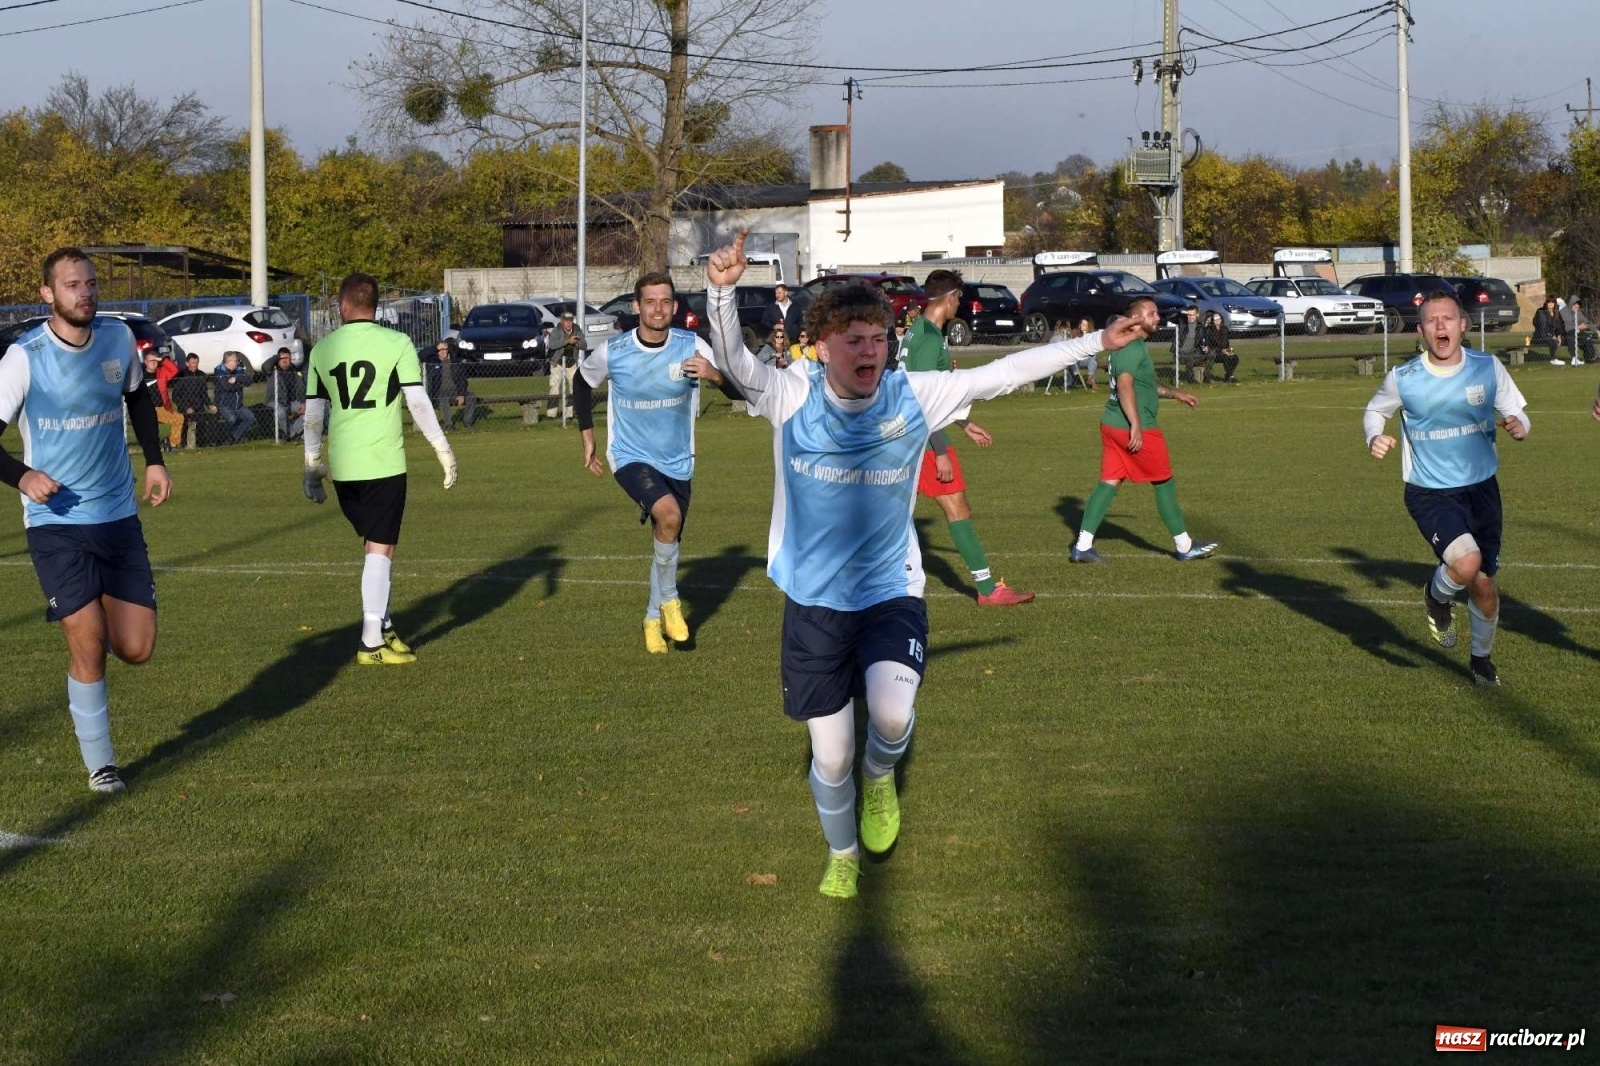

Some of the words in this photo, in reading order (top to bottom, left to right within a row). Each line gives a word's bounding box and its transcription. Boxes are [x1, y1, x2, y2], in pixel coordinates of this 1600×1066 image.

[329, 360, 377, 410] 12
[908, 638, 924, 663] 15
[894, 674, 915, 685] JAKO
